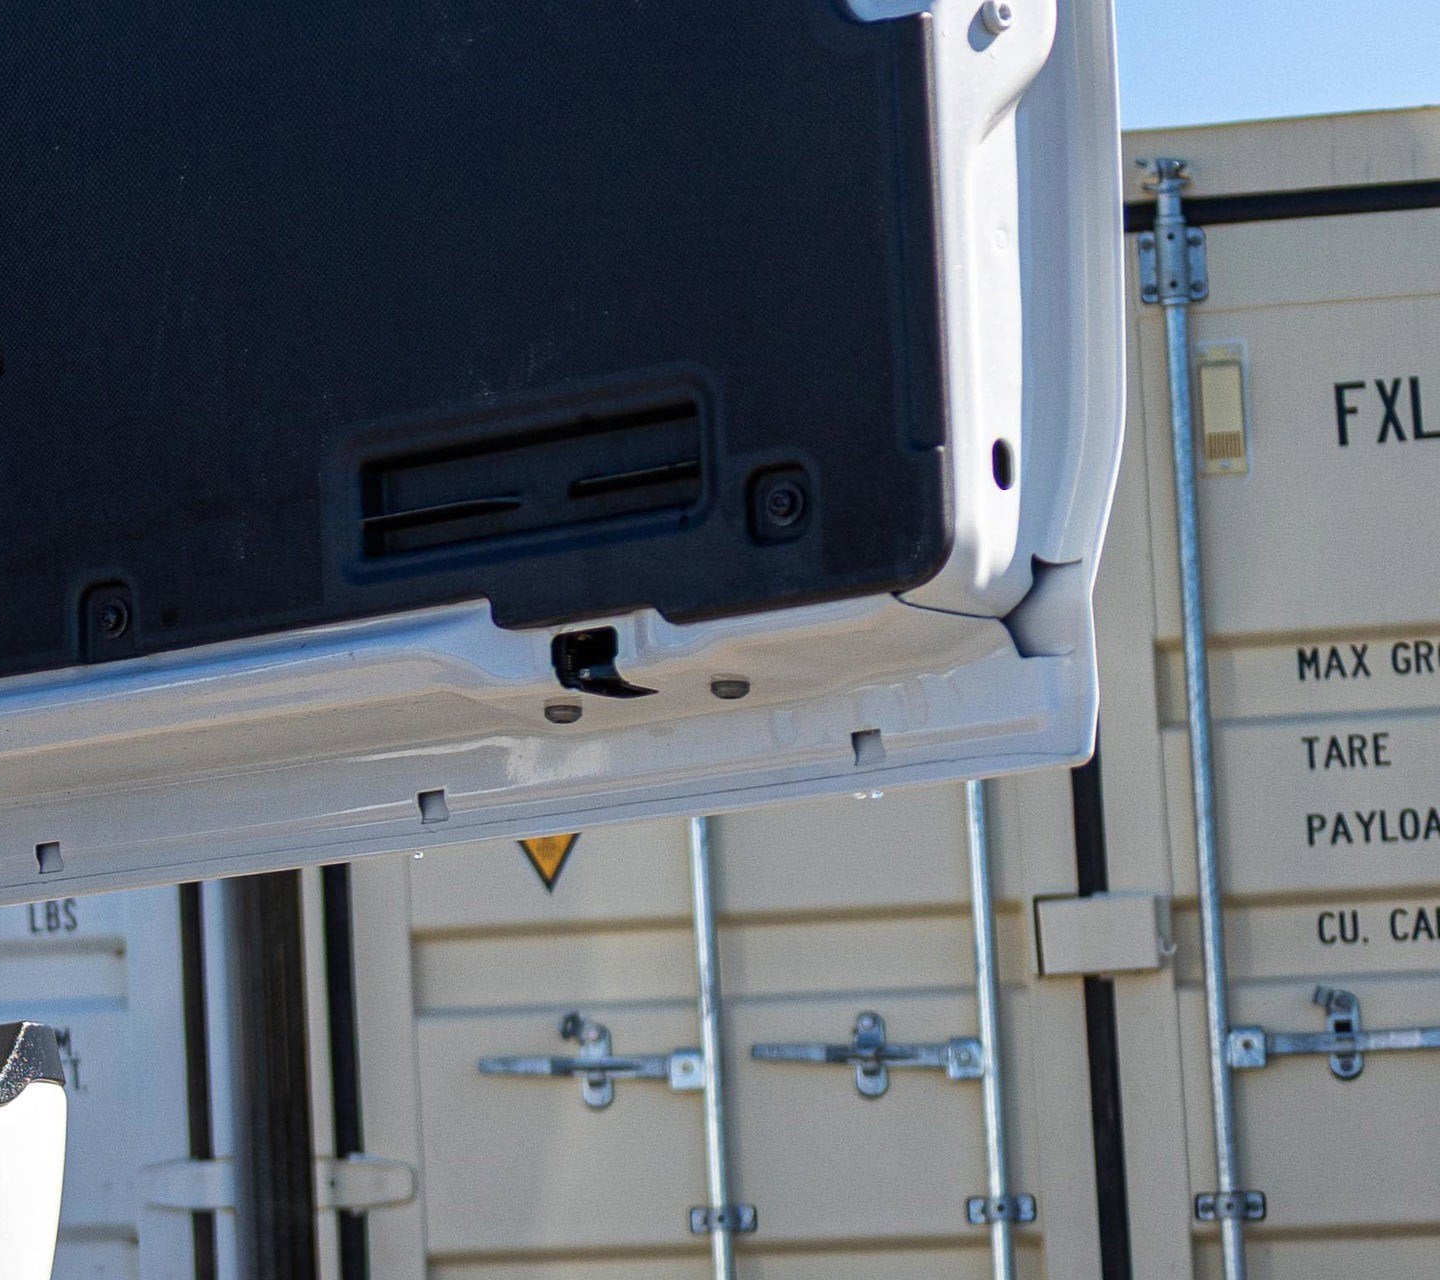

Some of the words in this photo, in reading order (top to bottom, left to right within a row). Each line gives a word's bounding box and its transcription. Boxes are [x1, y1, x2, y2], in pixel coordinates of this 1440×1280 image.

[1333, 375, 1440, 447] FXL
[1297, 643, 1371, 680] MAX
[1391, 639, 1440, 675] GR
[1301, 731, 1392, 770] TARE
[29, 897, 78, 932] LBS
[1318, 909, 1369, 944] CU.
[1390, 906, 1440, 941] CA
